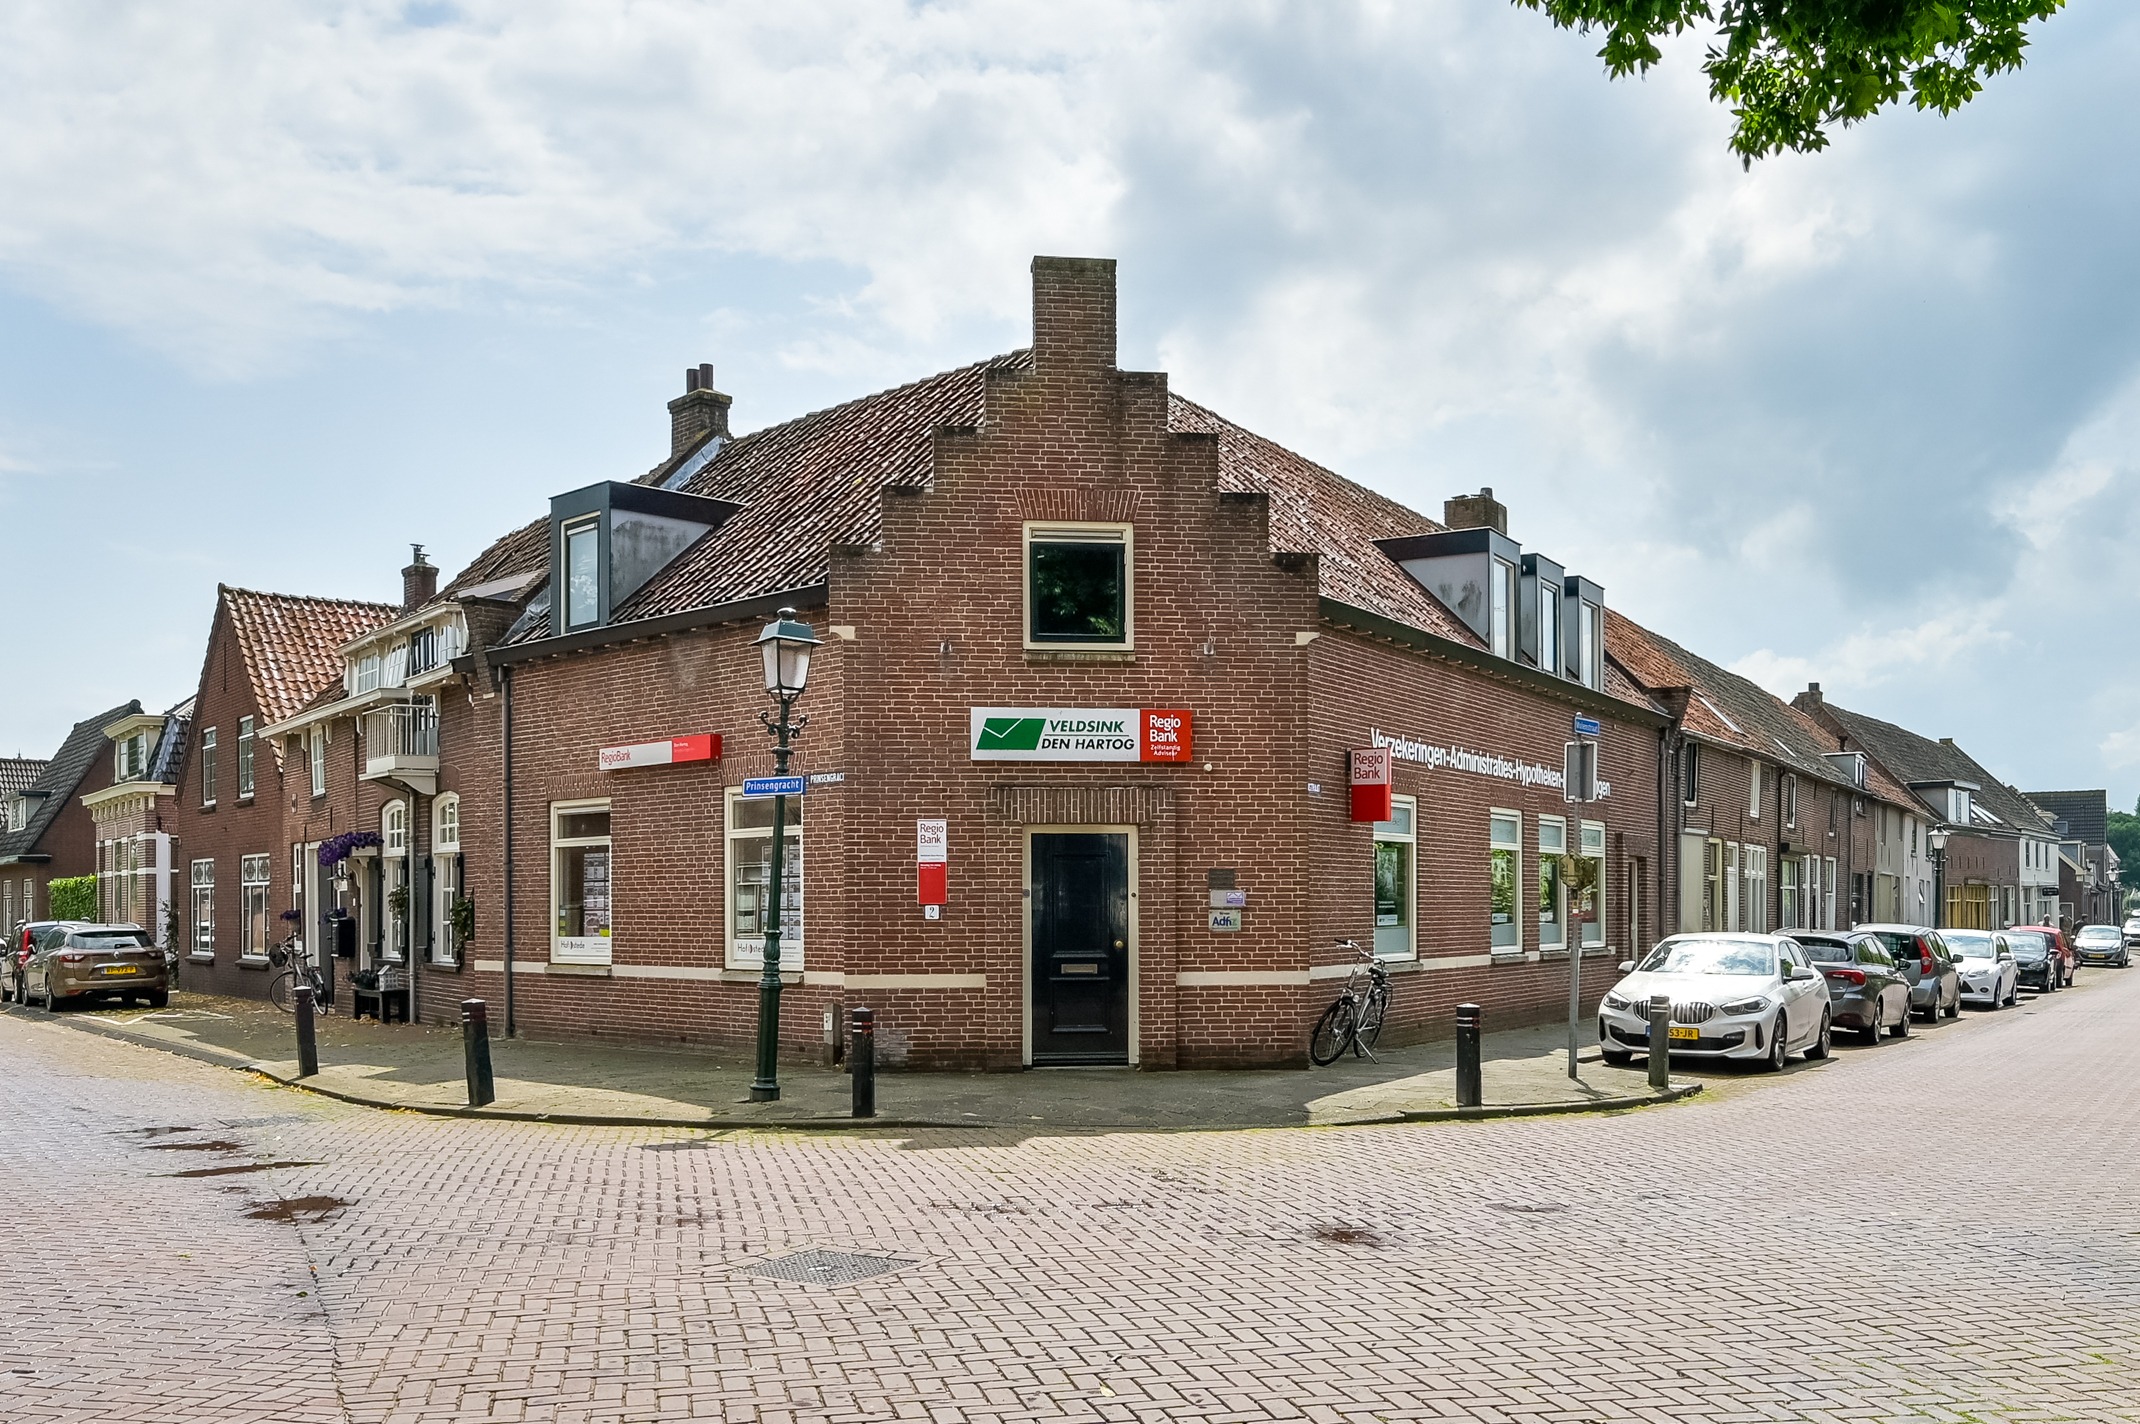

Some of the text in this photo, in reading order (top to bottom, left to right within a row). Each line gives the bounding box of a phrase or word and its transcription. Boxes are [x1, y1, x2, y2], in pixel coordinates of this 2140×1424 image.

[1049, 720, 1125, 733] VELDSINK
[1149, 714, 1181, 731] Regio
[1149, 728, 1178, 743] Bank
[1041, 738, 1135, 750] DEN HARTOG
[601, 748, 632, 765] RegioBank
[1354, 751, 1384, 768] Regio
[1354, 766, 1381, 779] Bank
[745, 780, 800, 792] Prinsengracht
[919, 823, 944, 835] Regio
[920, 834, 942, 844] Bank
[929, 906, 936, 918] 2
[1669, 1028, 1694, 1038] 53-JR
